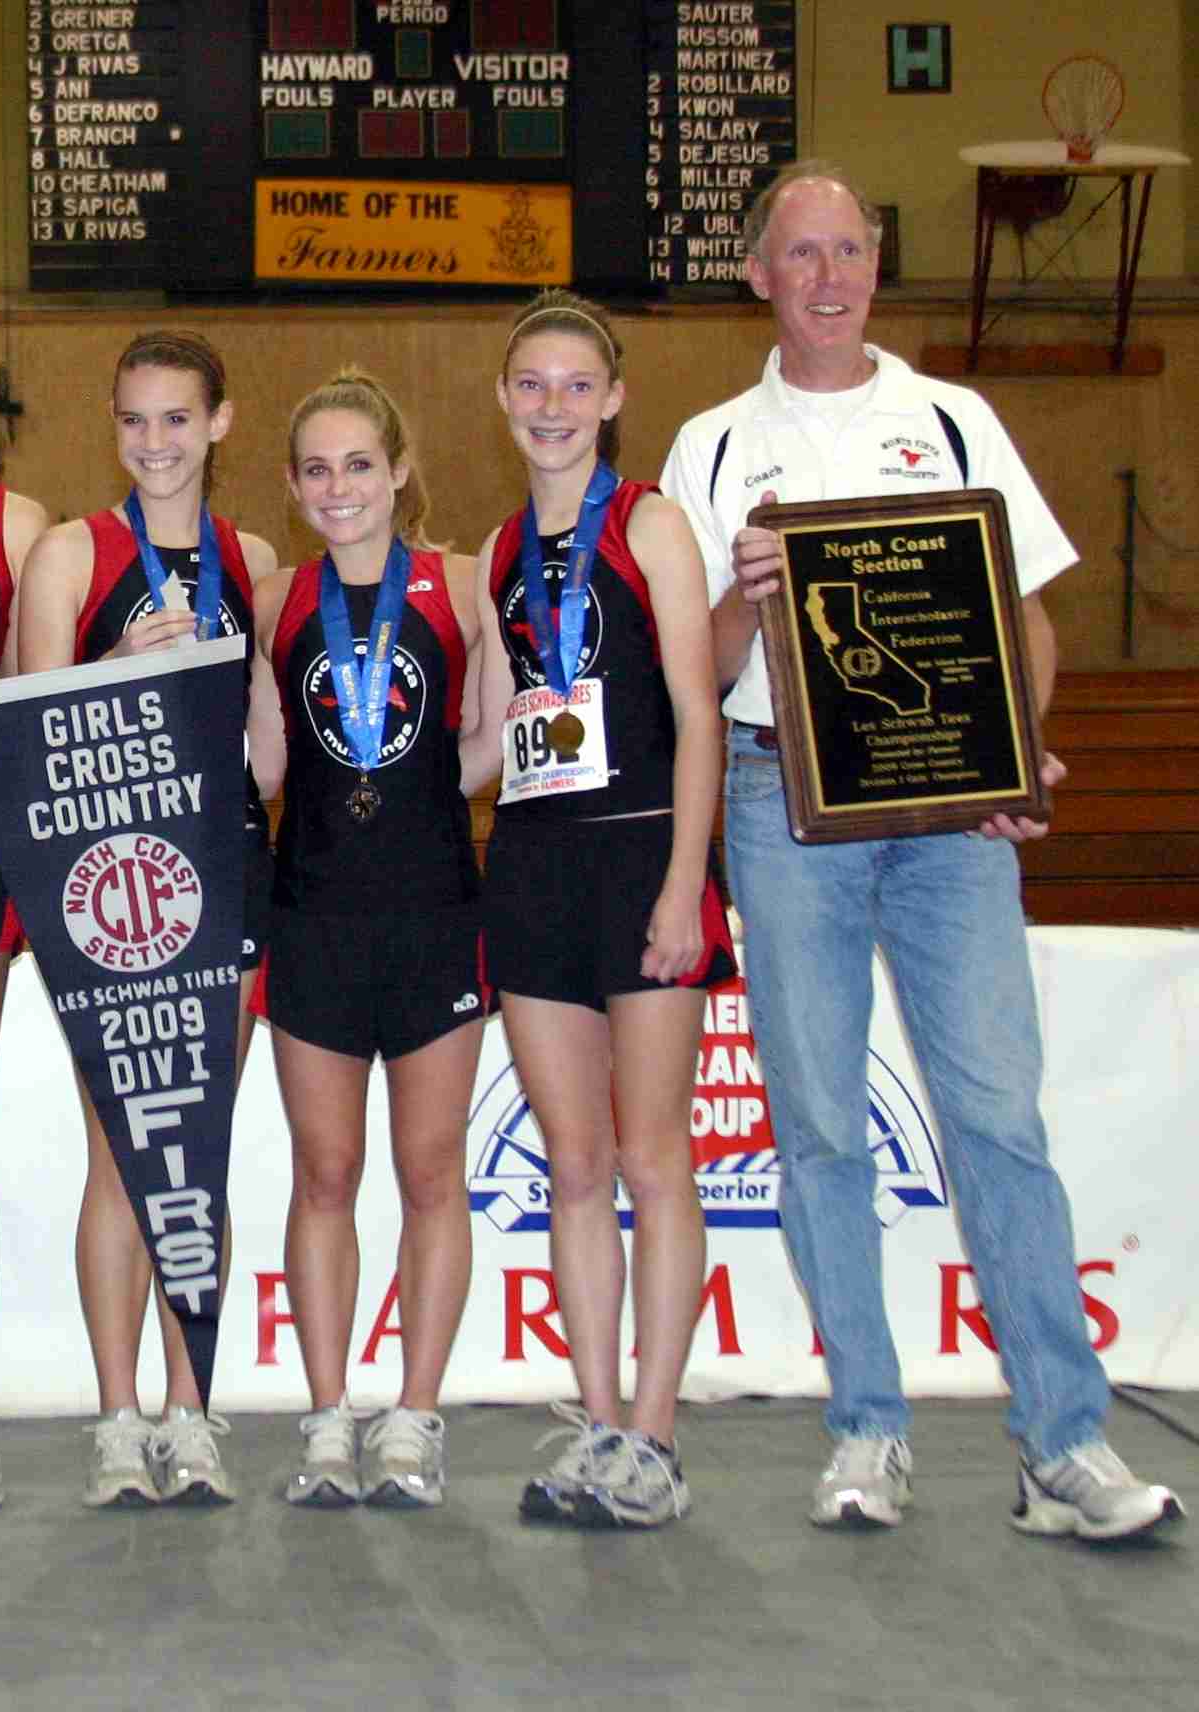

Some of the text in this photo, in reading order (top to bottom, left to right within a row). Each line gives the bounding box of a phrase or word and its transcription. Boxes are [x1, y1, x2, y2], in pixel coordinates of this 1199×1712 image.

[29, 9, 135, 28] 2 GREINER
[376, 6, 449, 24] PERIOD
[677, 4, 754, 23] SAUTER
[28, 32, 131, 51] 3 ORETGA
[677, 27, 759, 46] RUSSOM
[28, 56, 139, 75] 4 J RIVAS
[261, 55, 373, 80] HAYWARD
[454, 55, 569, 80] VISITOR
[677, 51, 775, 70] MARTINEZ
[893, 28, 941, 87] H
[29, 80, 91, 99] 5 ANI
[647, 74, 790, 93] 2 ROBILLARD
[261, 87, 333, 107] FOULS
[373, 88, 455, 109] PLAYER
[493, 87, 564, 107] FOULS
[29, 103, 159, 122] 6 DEFRANCO
[647, 98, 735, 117] 3 KWON
[30, 126, 137, 146] 7 BRANCH
[649, 122, 760, 140] 4 SALARY
[31, 151, 111, 170] 8 HALL
[648, 145, 770, 164] 5 DEJESUS
[33, 173, 166, 193] 10 CHEATHAM
[646, 169, 752, 187] 6 MILLER
[32, 199, 52, 216] 13
[270, 191, 459, 220] HOME OF THE
[646, 192, 742, 210] 9 DAVIS
[33, 222, 146, 240] 13 V RIVAS
[663, 215, 747, 235] 12 UBL
[277, 224, 461, 275] Farmers
[649, 239, 670, 257] 13
[650, 262, 670, 280] 14
[744, 465, 783, 488] Coach
[823, 535, 947, 559] North Coast
[851, 558, 923, 575] Section
[864, 590, 931, 605] California
[870, 609, 970, 627] Interscholastic
[890, 633, 963, 648] Federation
[42, 691, 164, 747] GIRLS
[515, 716, 579, 772] 89
[45, 735, 176, 791] CROSS
[27, 773, 202, 841] COUNTRY
[65, 836, 198, 915] NORTH COAST
[91, 857, 174, 943] CIF
[84, 919, 192, 968] SECTION
[57, 965, 239, 1013] LES SCHWAB TIRES
[100, 997, 206, 1051] 2009
[108, 1041, 210, 1095] DIV I
[691, 1097, 764, 1137] OUP
[123, 1086, 217, 1314] FIRST
